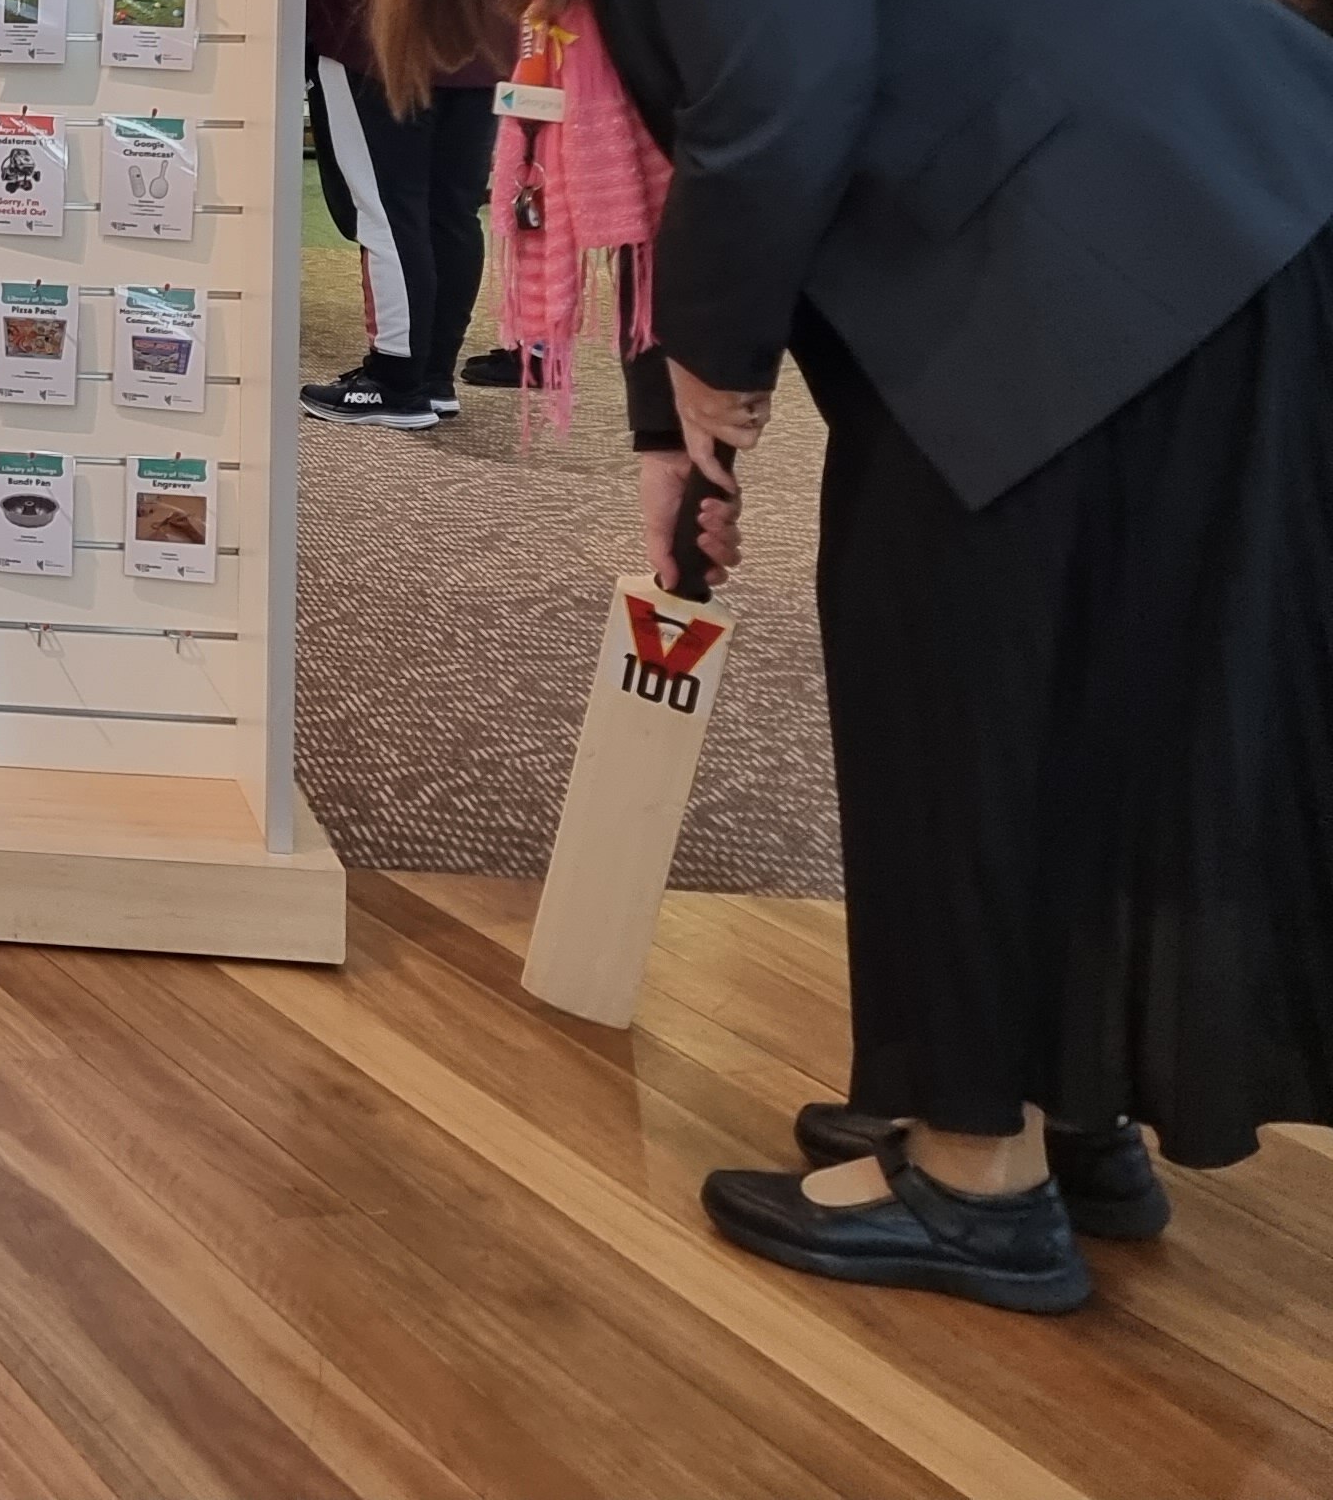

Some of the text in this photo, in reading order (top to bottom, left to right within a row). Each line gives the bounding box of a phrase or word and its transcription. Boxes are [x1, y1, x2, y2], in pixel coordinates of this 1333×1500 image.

[134, 140, 165, 150] Google
[123, 150, 174, 159] Chromecast
[11, 307, 57, 316] Pizza Panic
[344, 392, 383, 404] HOKA
[8, 478, 51, 487] Bundt Pan
[152, 481, 191, 490] Engraver
[621, 652, 701, 714] 100
